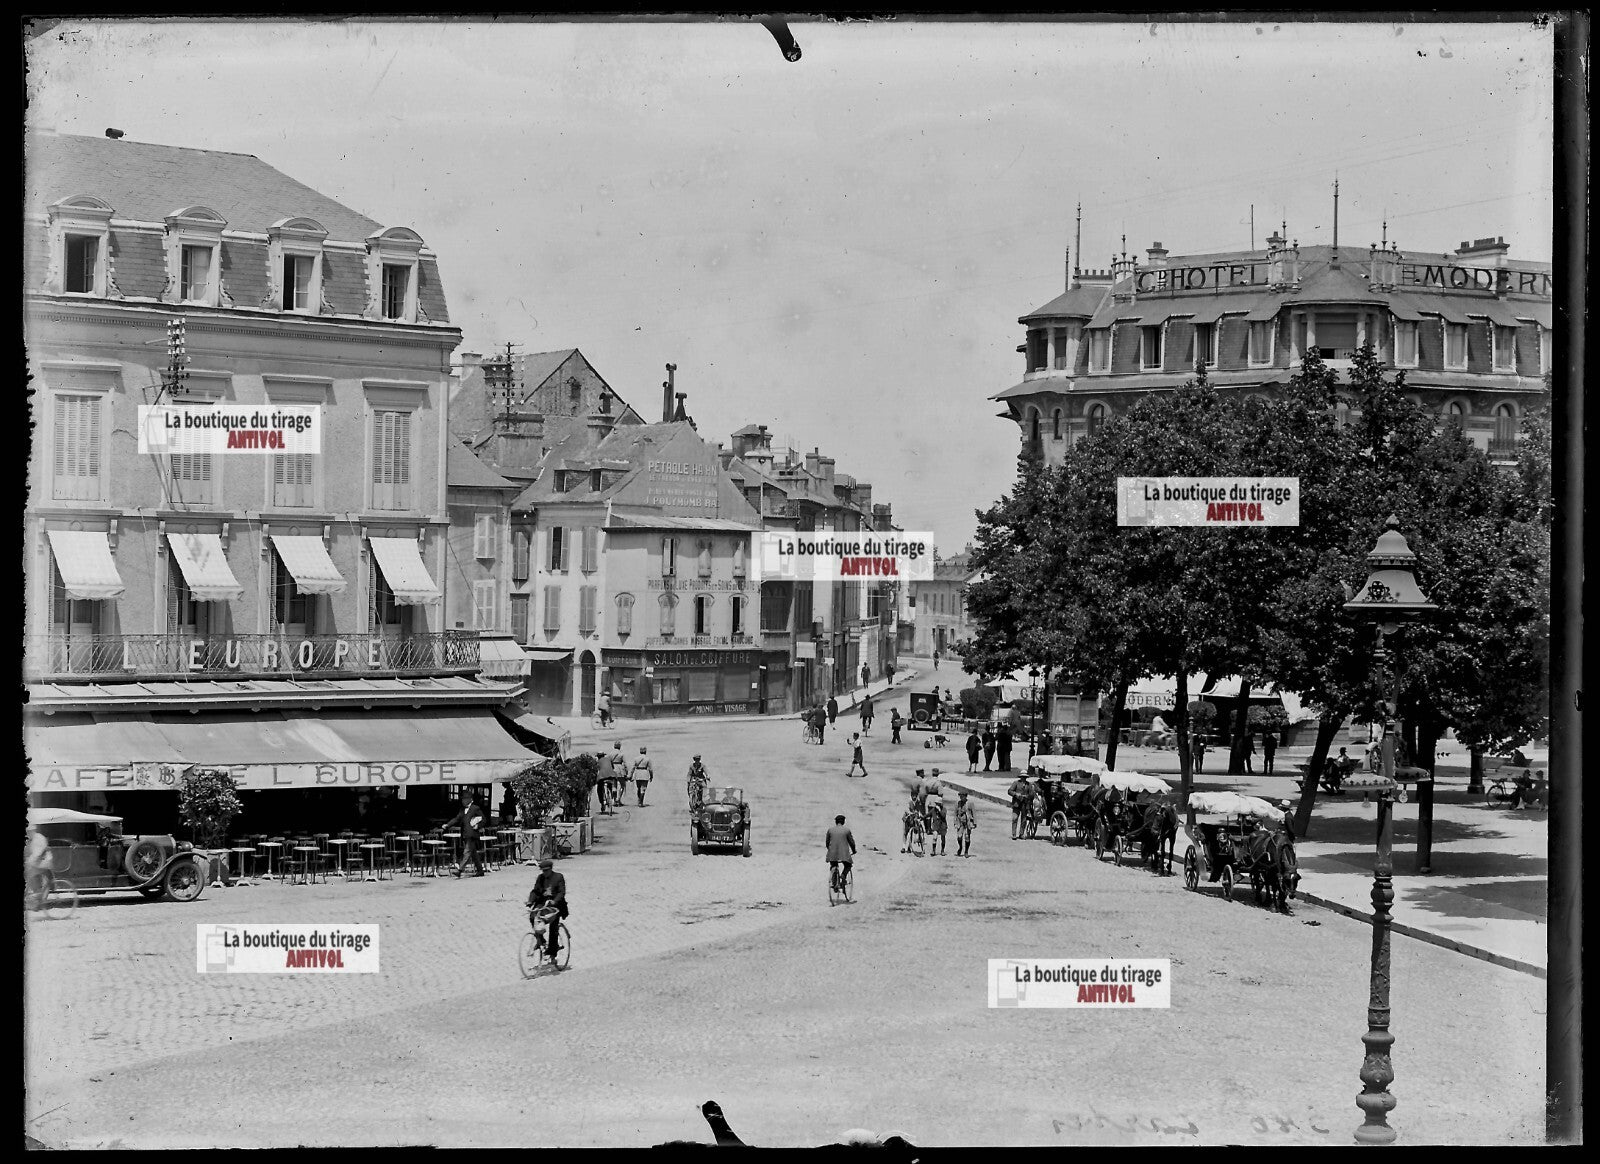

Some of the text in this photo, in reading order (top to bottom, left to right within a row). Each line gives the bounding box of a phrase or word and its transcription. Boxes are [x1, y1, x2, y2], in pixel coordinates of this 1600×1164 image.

[1171, 264, 1269, 290] HOTEL
[654, 653, 689, 666] SALON
[701, 652, 750, 665] COIFFURE
[724, 703, 747, 713] VISAGE
[30, 767, 129, 788] AFE
